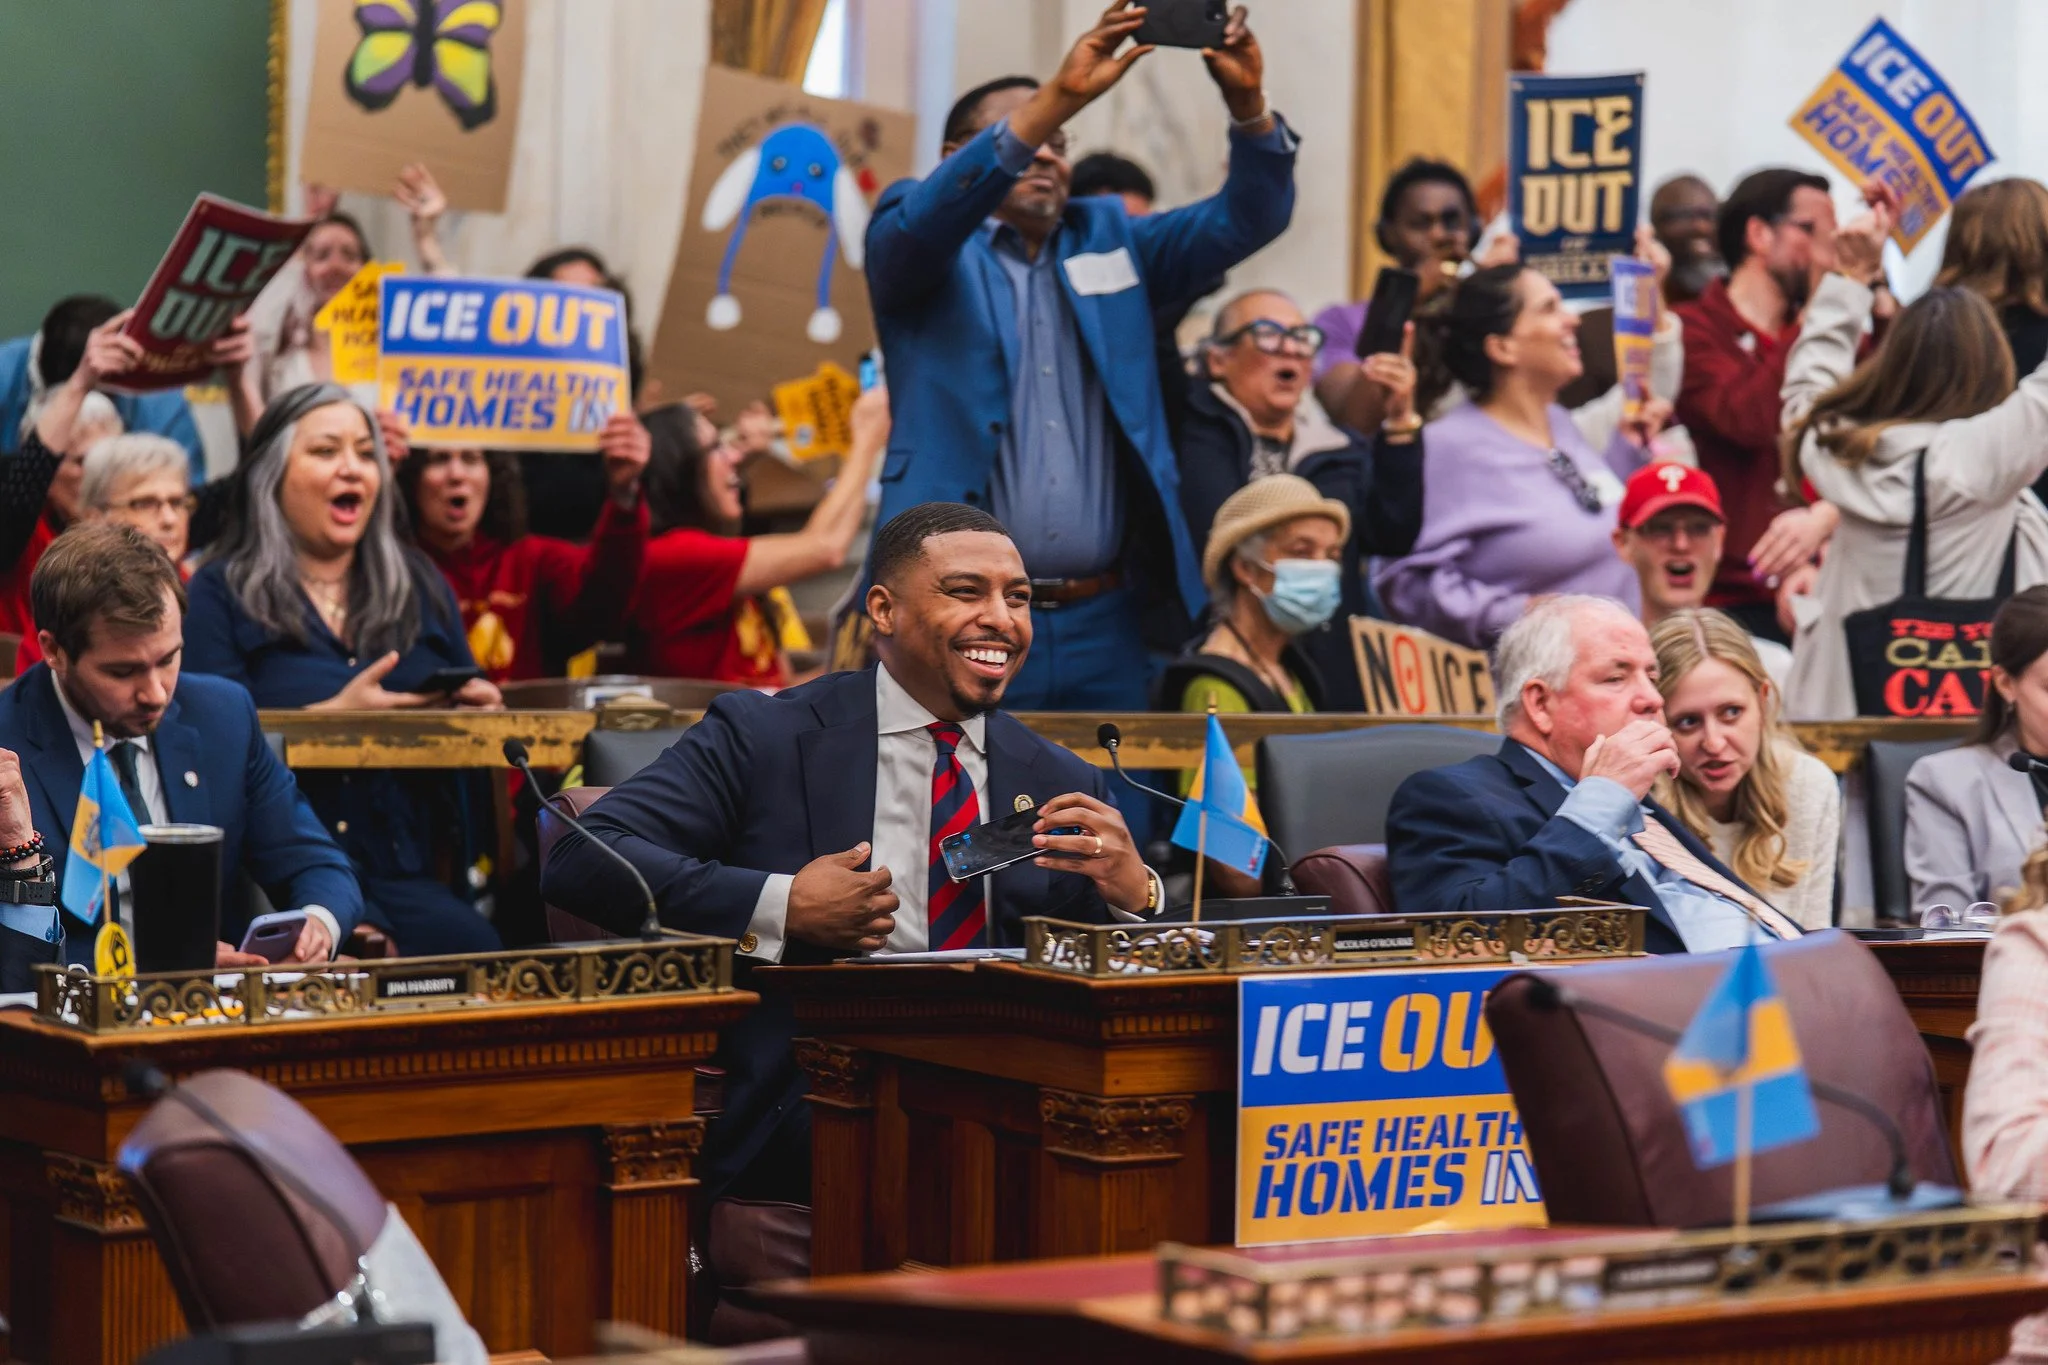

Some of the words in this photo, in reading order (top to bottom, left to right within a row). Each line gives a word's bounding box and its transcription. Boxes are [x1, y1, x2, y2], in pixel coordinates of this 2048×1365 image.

[1525, 95, 1632, 169] ICE
[1849, 32, 1932, 110] ICE
[1912, 90, 1986, 182] OUT
[1521, 170, 1633, 236] OUT
[181, 227, 292, 293] ICE
[150, 288, 232, 342] OU
[386, 291, 484, 342] ICE
[488, 291, 616, 350] OUT
[394, 392, 557, 430] HOMES
[400, 367, 476, 393] SAFE
[485, 369, 618, 398] HEALTHY
[1251, 1000, 1373, 1076] ICE
[1379, 991, 1495, 1073] OU
[1263, 1119, 1364, 1160] SAFE
[1373, 1111, 1524, 1153] HEALTH
[1252, 1153, 1467, 1219] HOMES
[1480, 1150, 1545, 1205] IN
